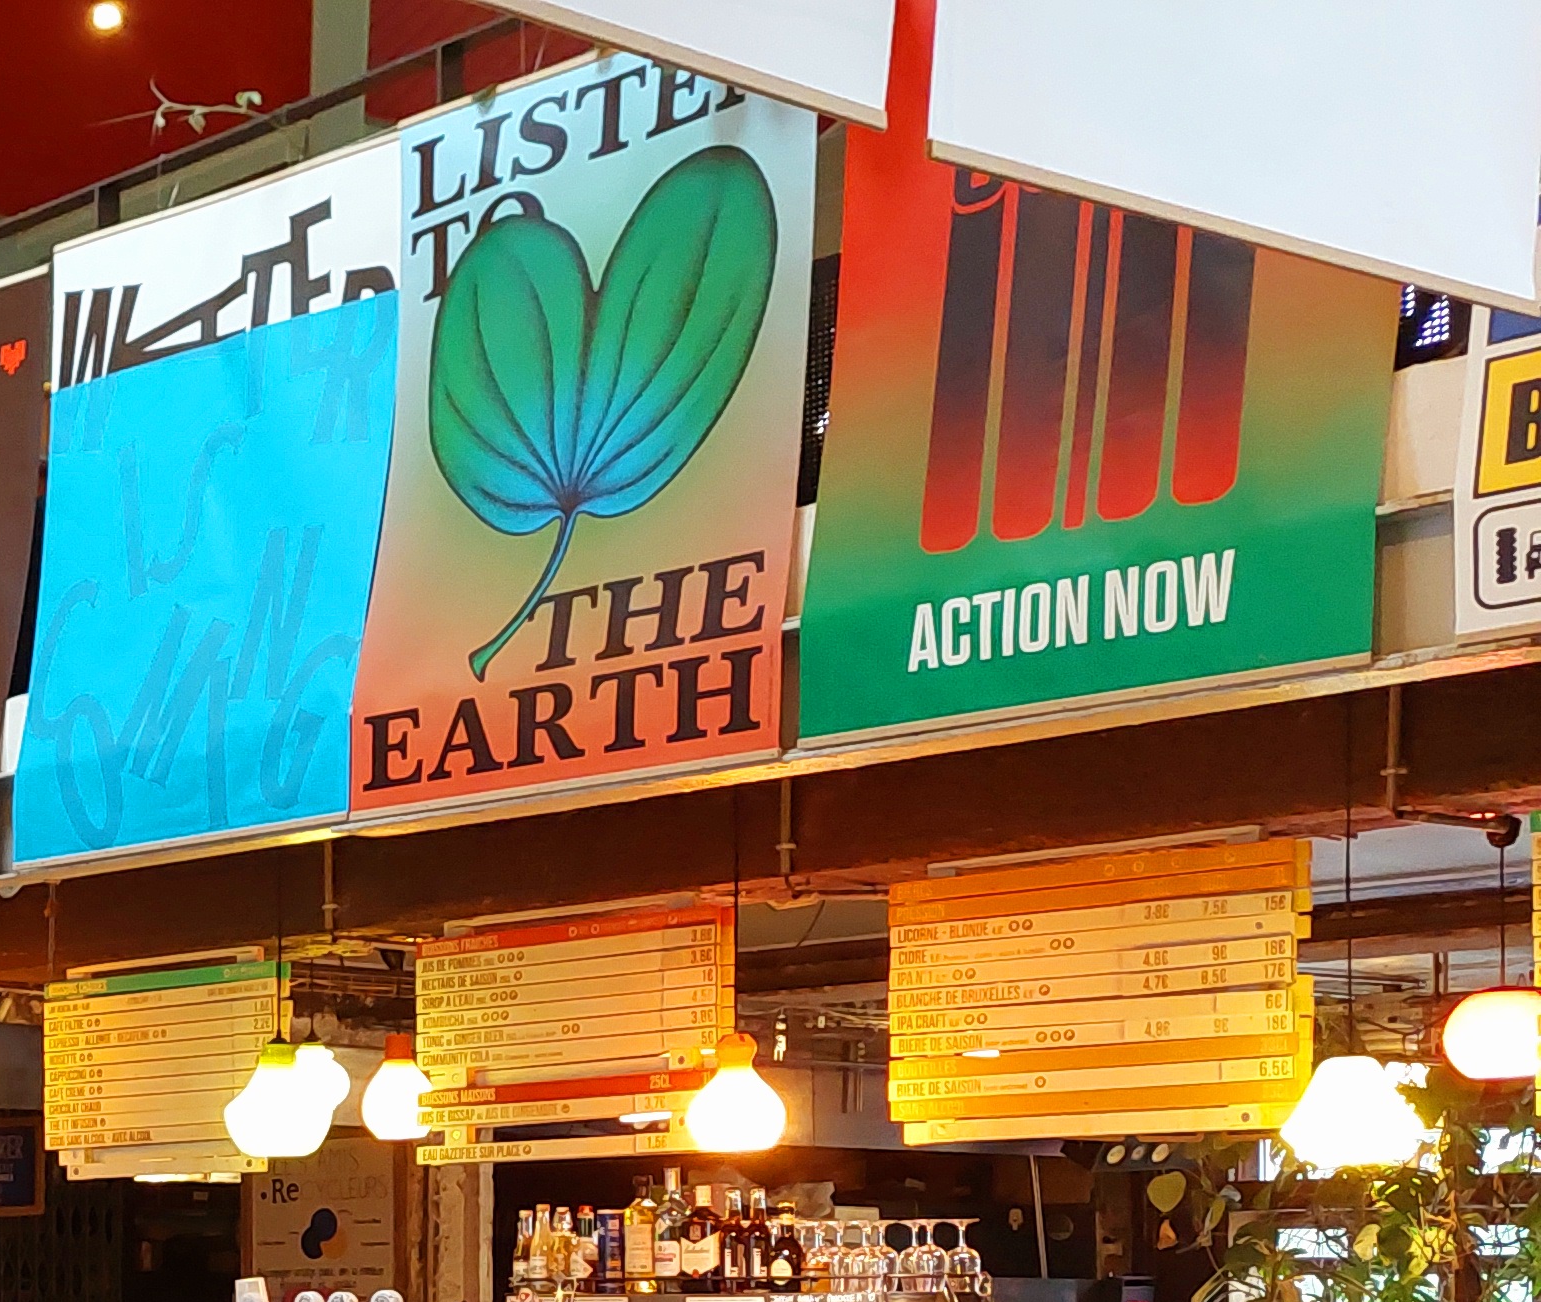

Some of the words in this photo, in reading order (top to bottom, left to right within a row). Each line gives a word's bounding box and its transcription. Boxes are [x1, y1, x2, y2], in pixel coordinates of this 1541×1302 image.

[410, 192, 544, 302] T
[1506, 378, 1541, 465] B
[527, 550, 765, 673] THE
[907, 574, 1091, 674] ACTION
[1102, 548, 1236, 641] NOW
[362, 645, 764, 793] EARTH
[898, 928, 939, 943] LICORNE
[949, 922, 989, 937] BLONDE
[1202, 900, 1228, 916] 7.5€
[1265, 895, 1286, 910] 15€
[421, 959, 434, 973] JUS
[436, 958, 446, 971] DE
[448, 955, 482, 970] POMMES
[897, 973, 912, 986] IPA
[1212, 945, 1228, 961] 9€
[898, 950, 927, 965] CIDRE
[421, 977, 455, 991] NECTARS
[458, 975, 468, 987] DE
[470, 972, 498, 986] SAISON
[896, 992, 942, 1008] BLANCHE
[946, 990, 958, 1004] DE
[962, 985, 1020, 1003] BRUXELLES
[1263, 963, 1286, 979] 17€
[422, 997, 444, 1010] SIROP
[897, 1016, 912, 1029] IPA
[916, 1013, 947, 1028] CRAFT
[1265, 994, 1283, 1009] 6€
[423, 1014, 465, 1029] KOMBUCHA
[422, 1036, 444, 1048] TONIC
[454, 1032, 482, 1045] GINGER
[484, 1030, 504, 1043] BEER
[898, 1037, 928, 1053] BIERE
[930, 1036, 942, 1051] DE
[946, 1035, 982, 1049] SAISON
[1214, 1018, 1229, 1033] 9€
[423, 1049, 469, 1066] COMMUNITY
[470, 1049, 491, 1062] COLA
[897, 1082, 925, 1097] BIERE
[928, 1081, 940, 1095] DE
[944, 1079, 981, 1094] SAISON
[1259, 1061, 1289, 1076] 6.5€
[420, 1090, 459, 1105] BOISSONS
[420, 1110, 435, 1125] JUS
[67, 1134, 82, 1145] SANS
[112, 1131, 127, 1142] AVEC
[422, 1147, 439, 1161] EAU
[479, 1145, 494, 1158] SUR
[496, 1144, 521, 1157] PLACE
